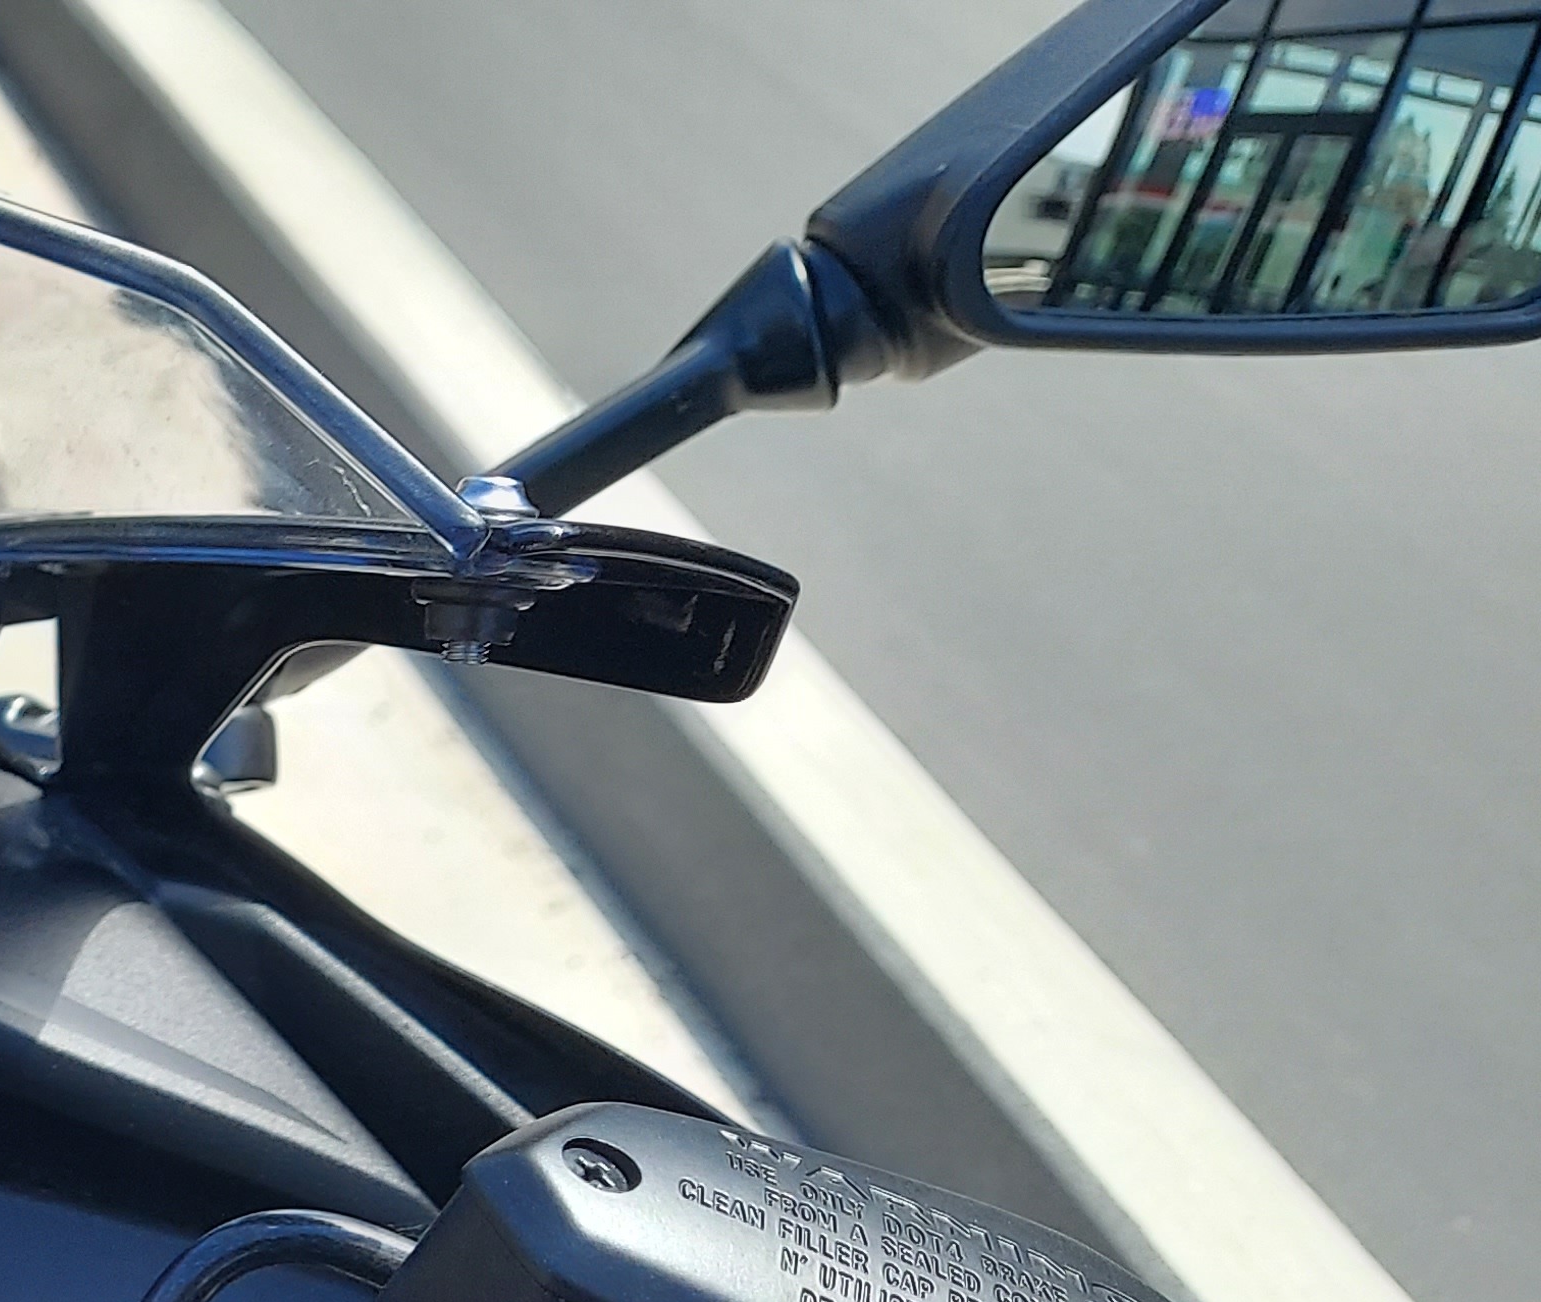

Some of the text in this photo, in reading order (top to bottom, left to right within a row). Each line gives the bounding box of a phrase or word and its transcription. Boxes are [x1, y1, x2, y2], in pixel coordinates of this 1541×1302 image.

[677, 1177, 767, 1232] CLEAN
[777, 1217, 870, 1275] FILLER
[881, 1260, 936, 1300] CAP
[725, 1150, 779, 1187] USE
[799, 1181, 866, 1221] ONLY
[881, 1212, 964, 1262] DOT4
[763, 1187, 838, 1234] FROM
[849, 1223, 869, 1246] A
[880, 1234, 982, 1295] SEALED
